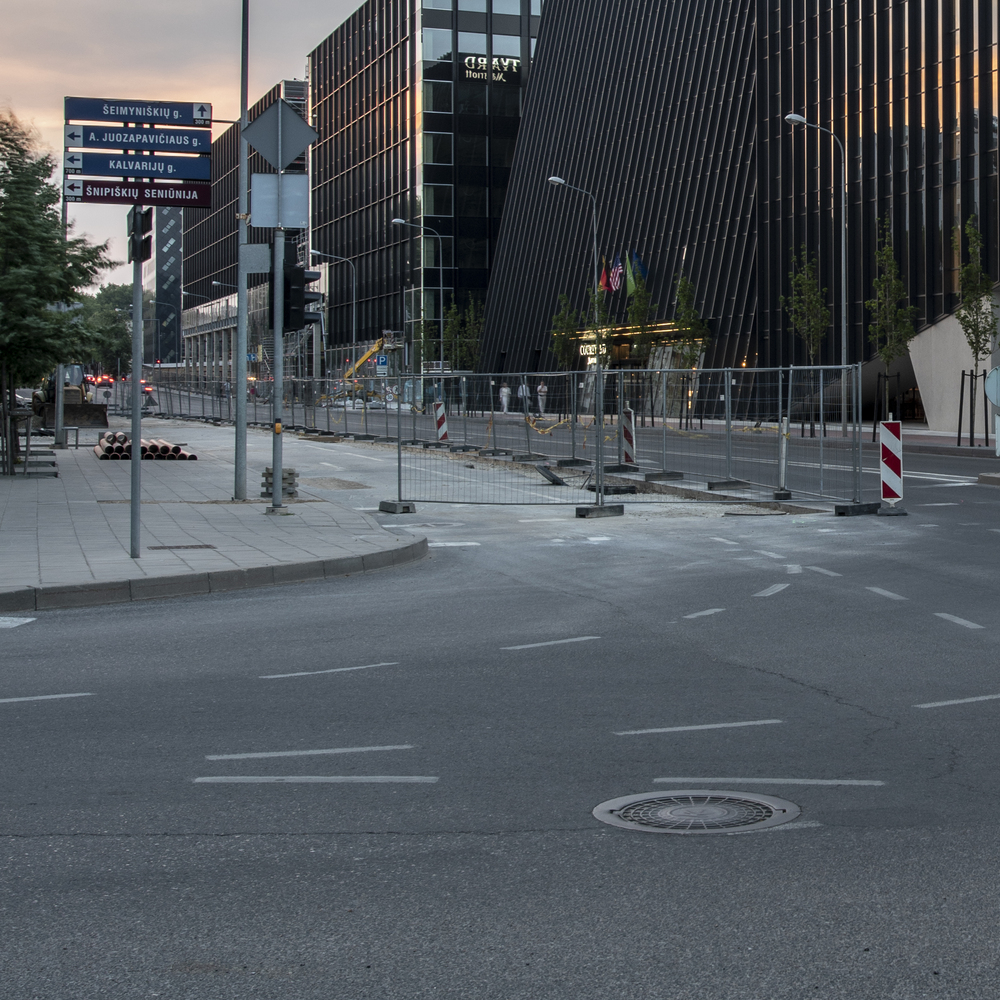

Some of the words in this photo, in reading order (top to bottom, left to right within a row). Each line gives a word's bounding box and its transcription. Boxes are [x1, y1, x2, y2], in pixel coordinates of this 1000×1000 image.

[102, 104, 170, 119] ŠEIMYNIŠKIŲ
[173, 109, 182, 118] g.
[89, 132, 99, 141] A.
[102, 133, 189, 145] JUOZAPAVIČIAUS
[192, 138, 202, 147] g.
[109, 160, 165, 173] KALVARIJŲ
[167, 165, 177, 173] g.
[86, 185, 139, 200] ŠNIPIŠKIŲ
[144, 187, 198, 200] SENIŪNIJA
[379, 356, 386, 365] P
